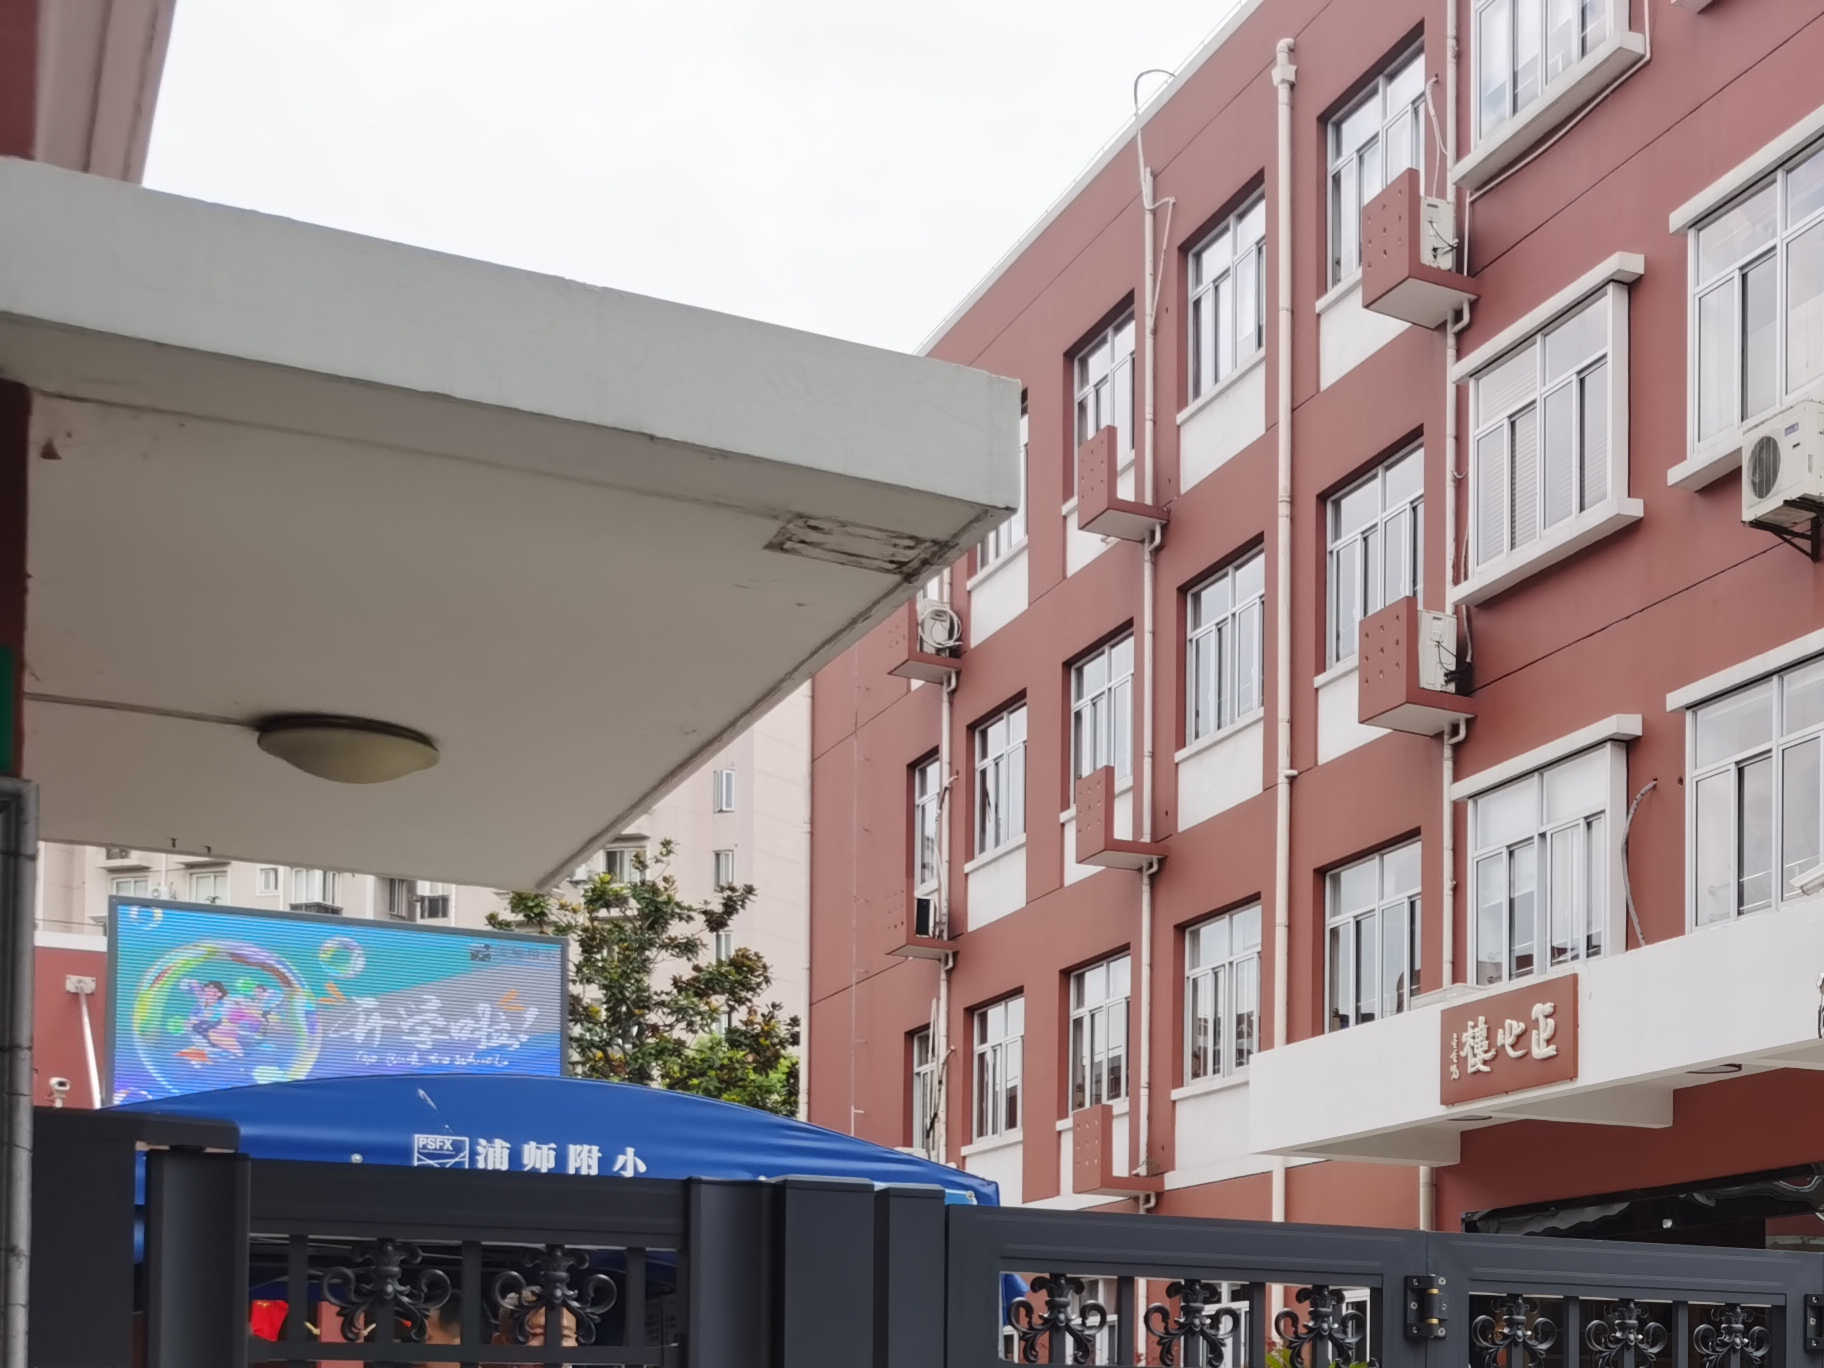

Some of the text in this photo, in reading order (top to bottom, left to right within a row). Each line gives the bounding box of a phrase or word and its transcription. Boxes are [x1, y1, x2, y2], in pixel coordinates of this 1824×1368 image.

[418, 1137, 454, 1152] PSFX
[476, 1138, 647, 1178] 浦师附小
